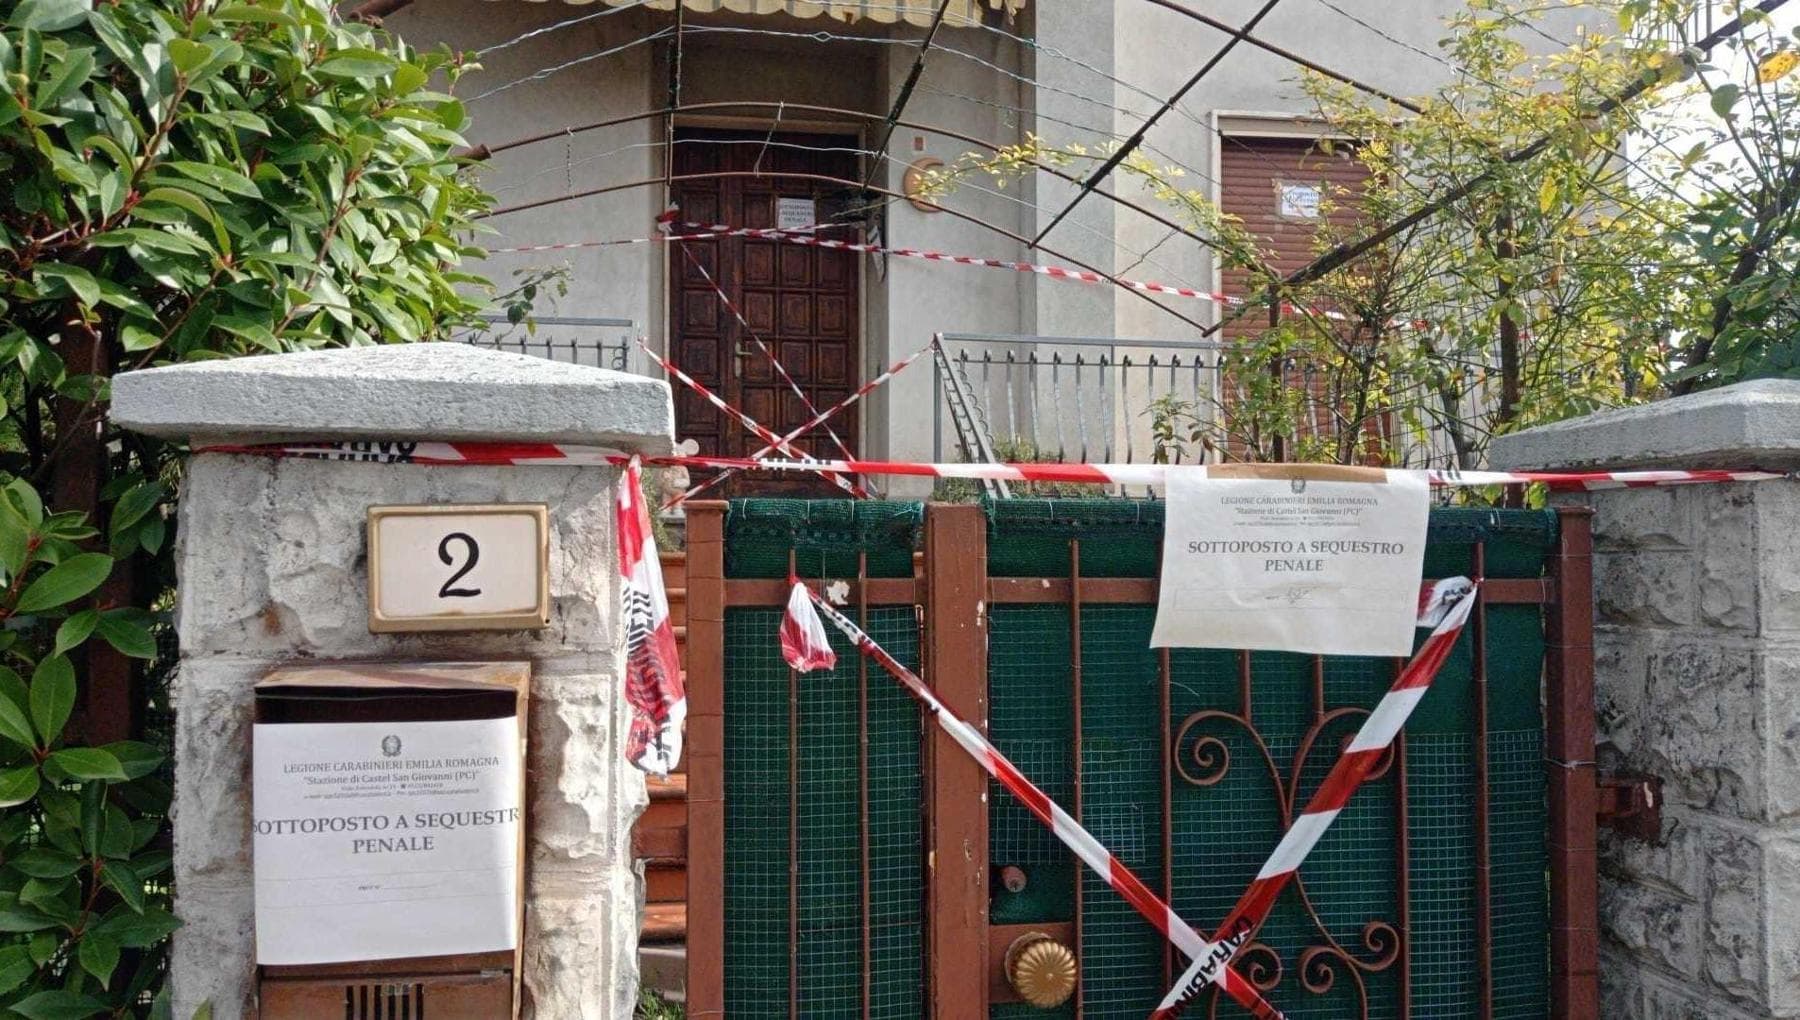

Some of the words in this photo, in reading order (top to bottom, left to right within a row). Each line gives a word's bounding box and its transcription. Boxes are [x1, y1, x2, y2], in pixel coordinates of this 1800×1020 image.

[1188, 540, 1293, 554] SOTTOPOSTO
[1296, 540, 1307, 553] A
[1310, 540, 1404, 555] SEQUESTRO
[438, 532, 482, 598] 2
[1264, 559, 1325, 572] PENALE
[283, 762, 332, 774] LEGIONE
[332, 760, 403, 773] CARABINIERI
[405, 759, 443, 770] EMILIA
[445, 756, 500, 769] ROMAGNA
[350, 775, 359, 783] di
[361, 773, 390, 783] Castel
[393, 773, 410, 781] San
[411, 772, 453, 781] Giovanni
[395, 814, 409, 829] A
[351, 836, 435, 854] PENALE
